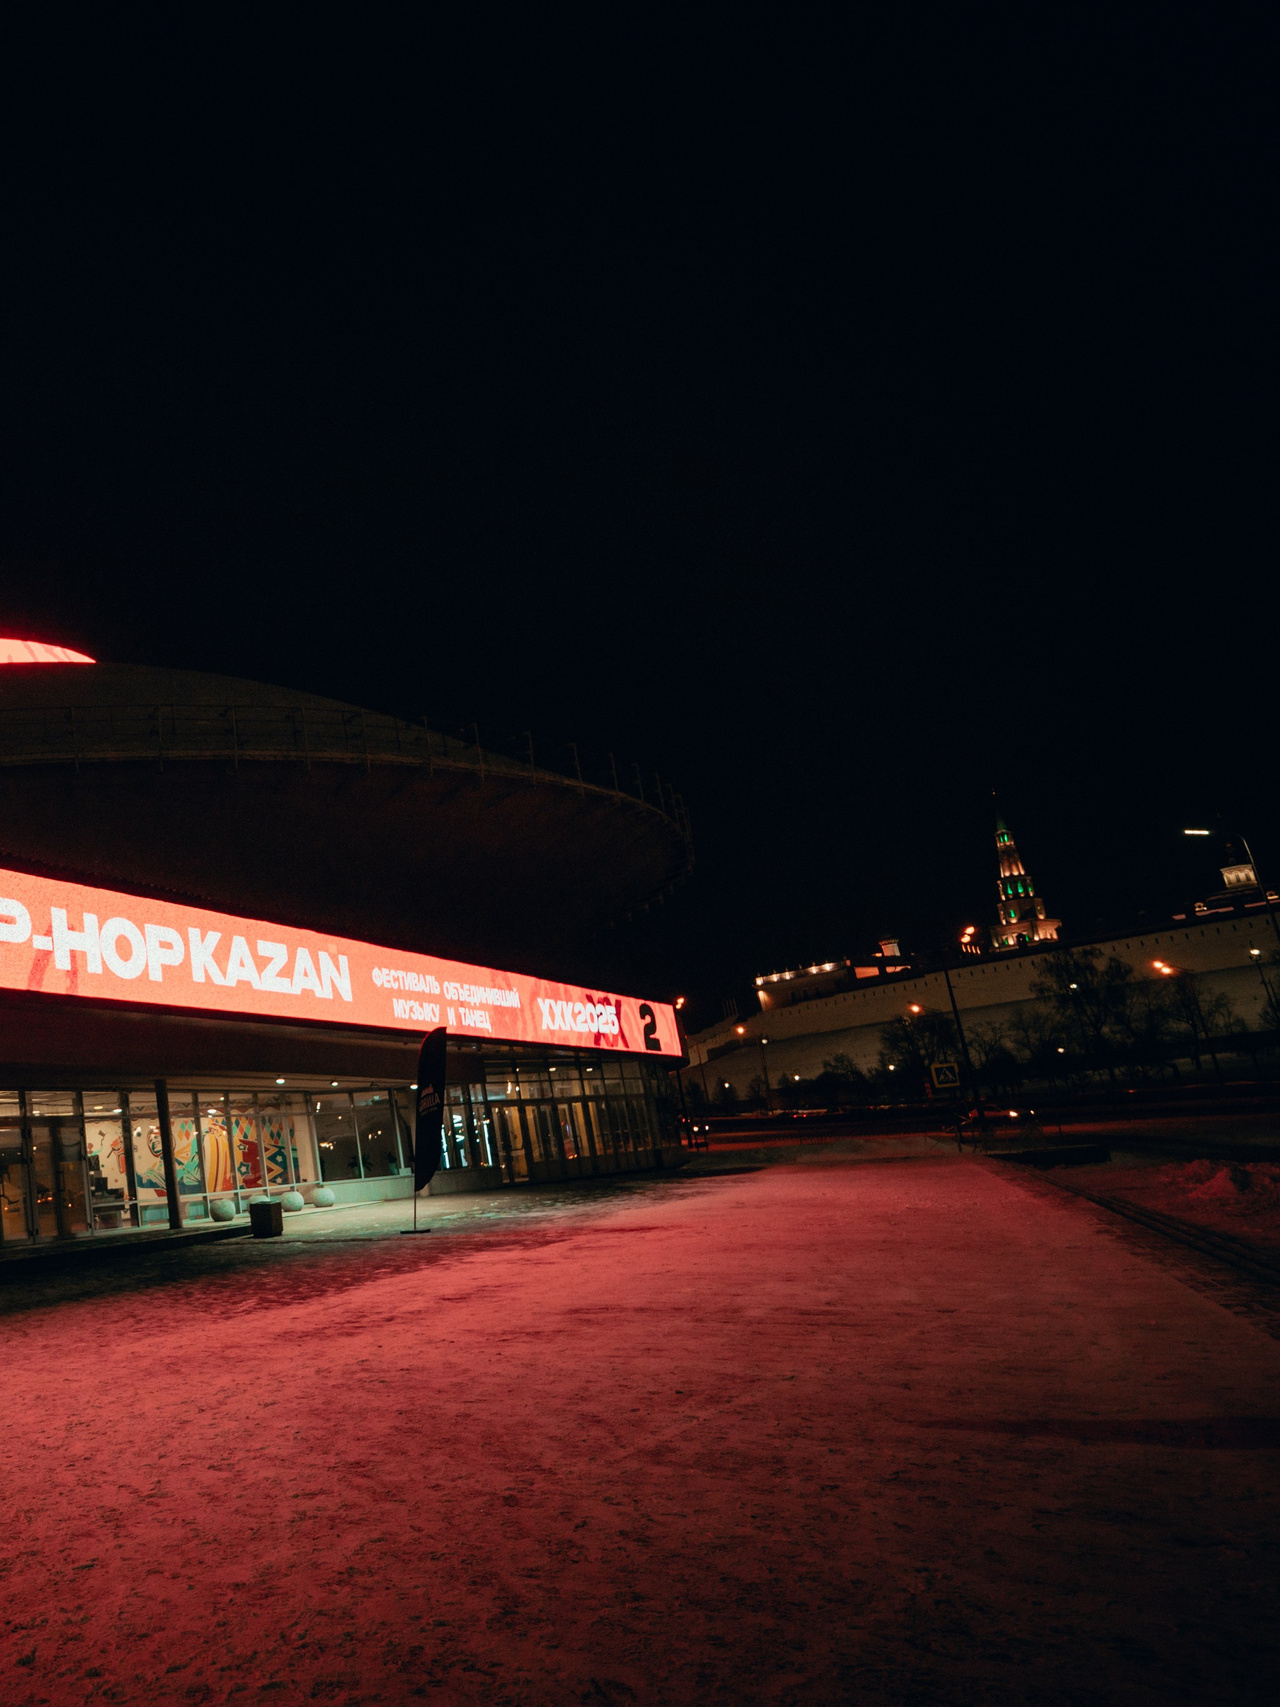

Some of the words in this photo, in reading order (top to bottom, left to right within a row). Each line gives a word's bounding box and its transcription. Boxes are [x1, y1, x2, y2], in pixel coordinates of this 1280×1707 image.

[187, 926, 353, 1002] KAZAN
[371, 966, 441, 995] ФЕСТИВАЛЬ
[392, 998, 440, 1023] МУЗЫКУ
[447, 1006, 457, 1026] И
[458, 1006, 493, 1033] ТАНЕЦ
[639, 1003, 662, 1052] 2
